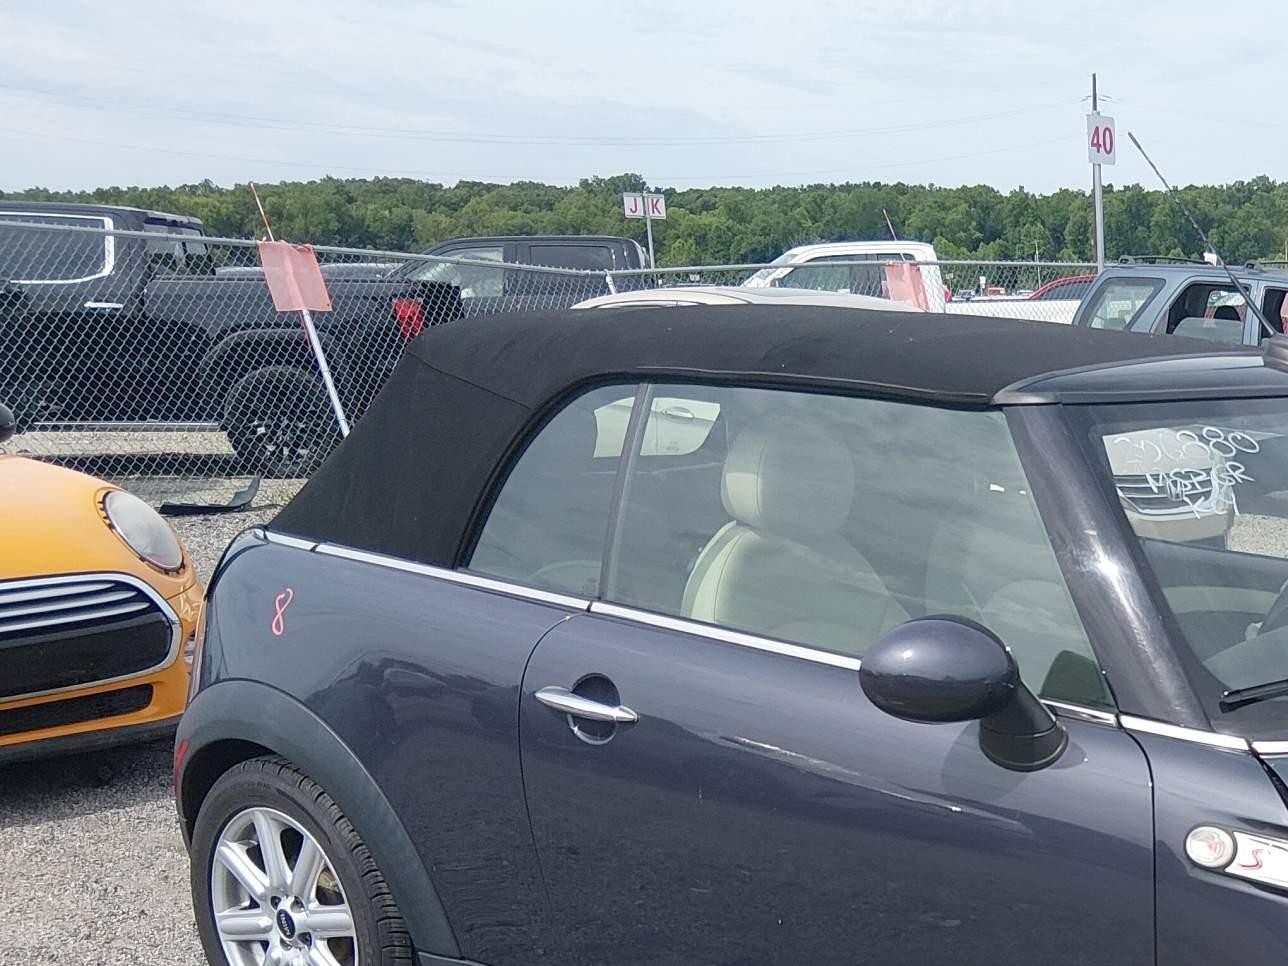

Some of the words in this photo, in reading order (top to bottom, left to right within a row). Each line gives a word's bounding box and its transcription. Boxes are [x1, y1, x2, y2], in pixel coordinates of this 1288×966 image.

[1090, 126, 1114, 155] 40
[630, 197, 638, 214] J
[651, 198, 662, 215] K
[272, 588, 294, 636] 8
